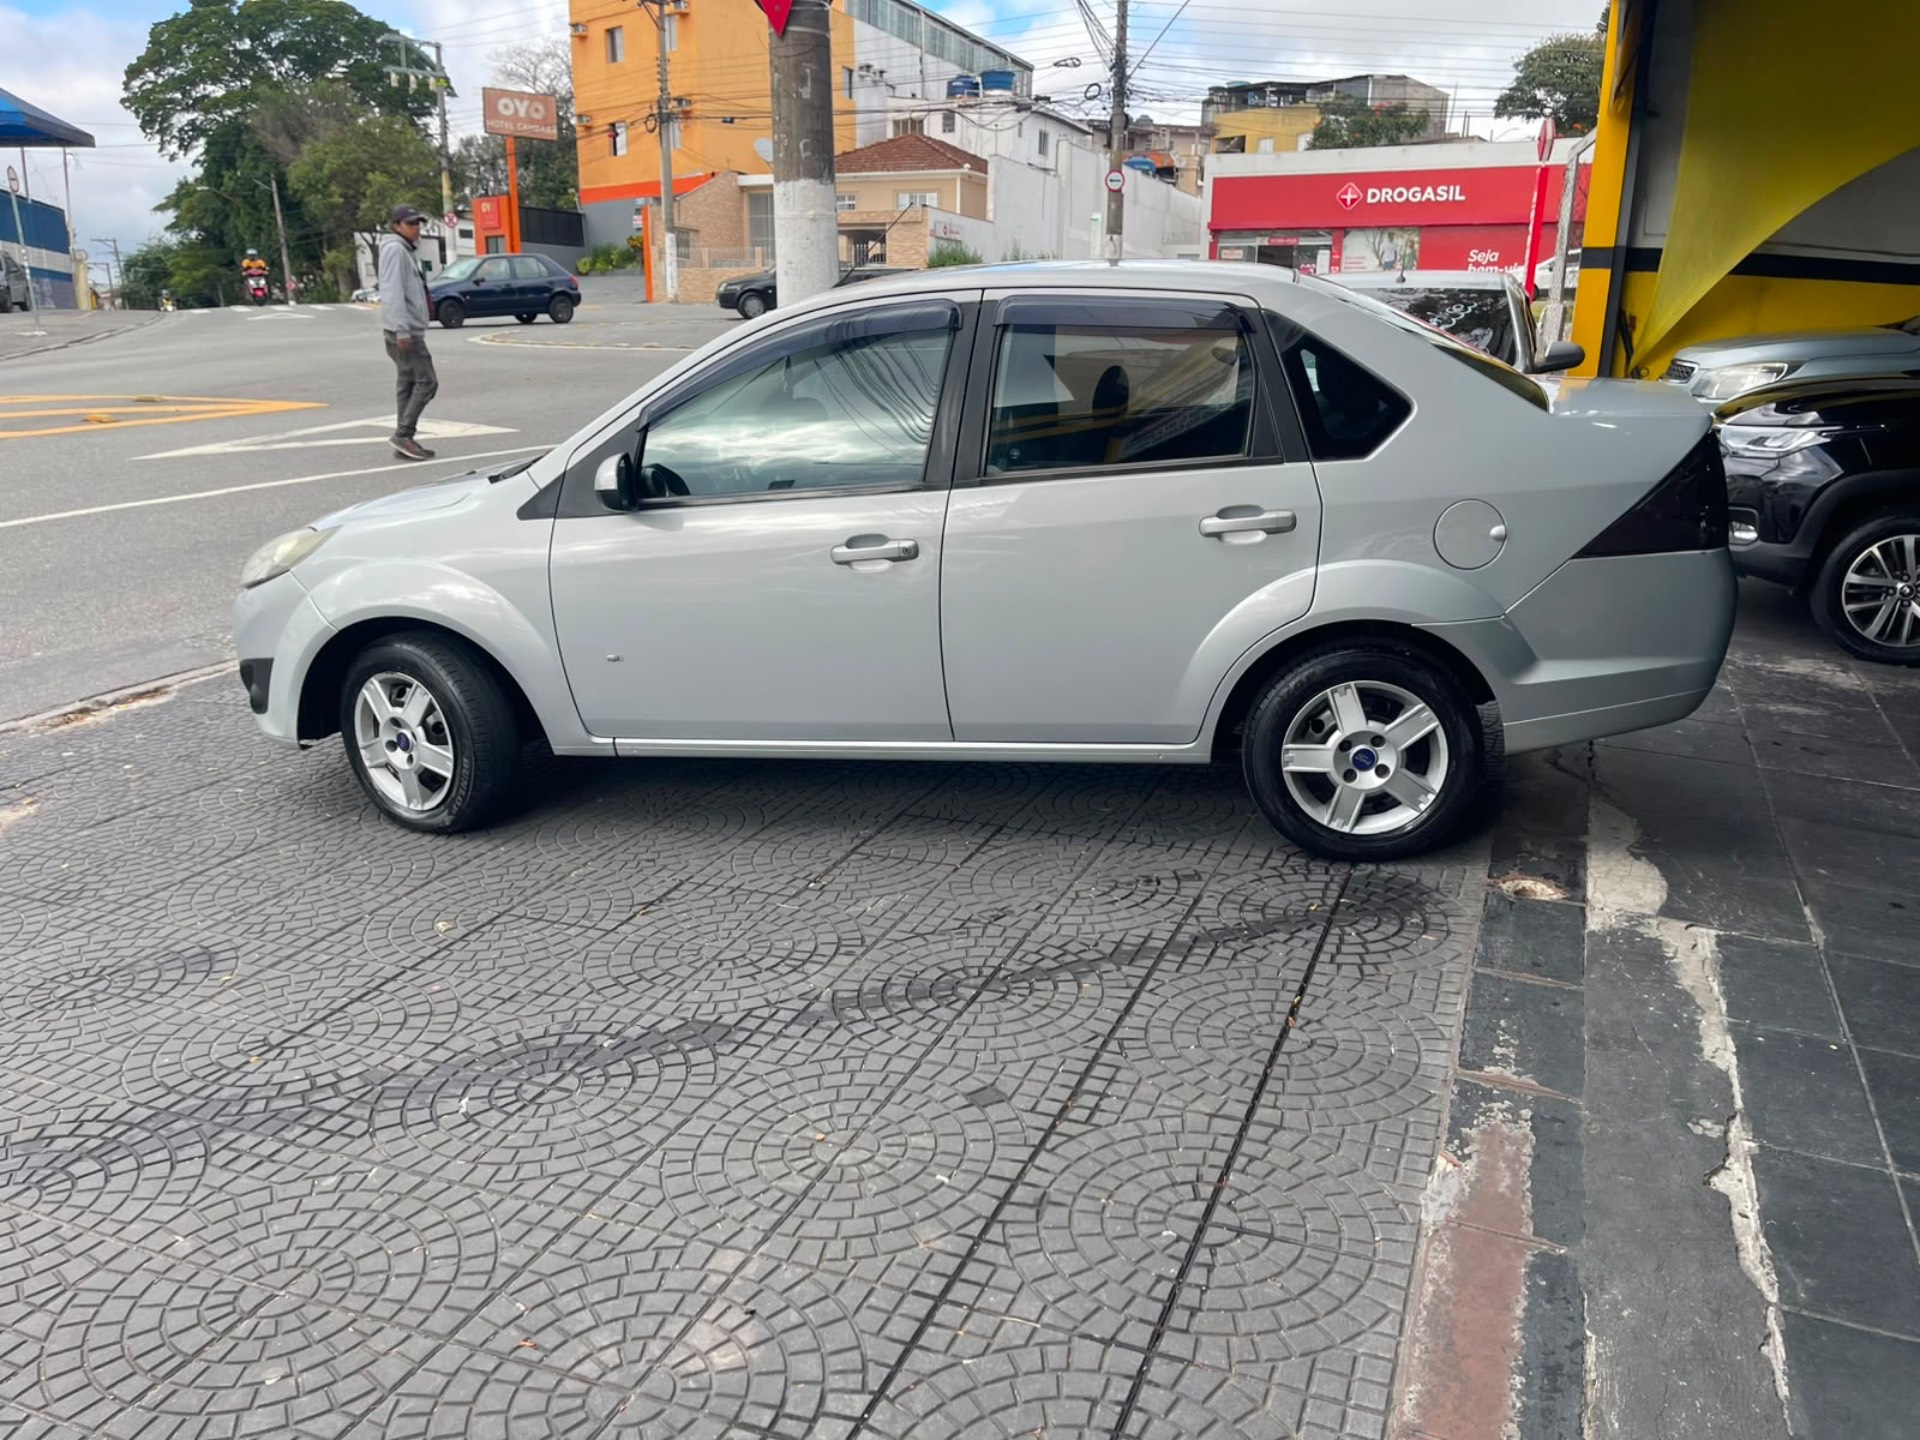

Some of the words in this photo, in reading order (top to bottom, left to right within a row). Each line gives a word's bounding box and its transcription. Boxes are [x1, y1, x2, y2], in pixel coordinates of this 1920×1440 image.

[497, 97, 545, 119] OYO
[1366, 185, 1466, 204] DROGASIL
[1467, 249, 1500, 265] Seja
